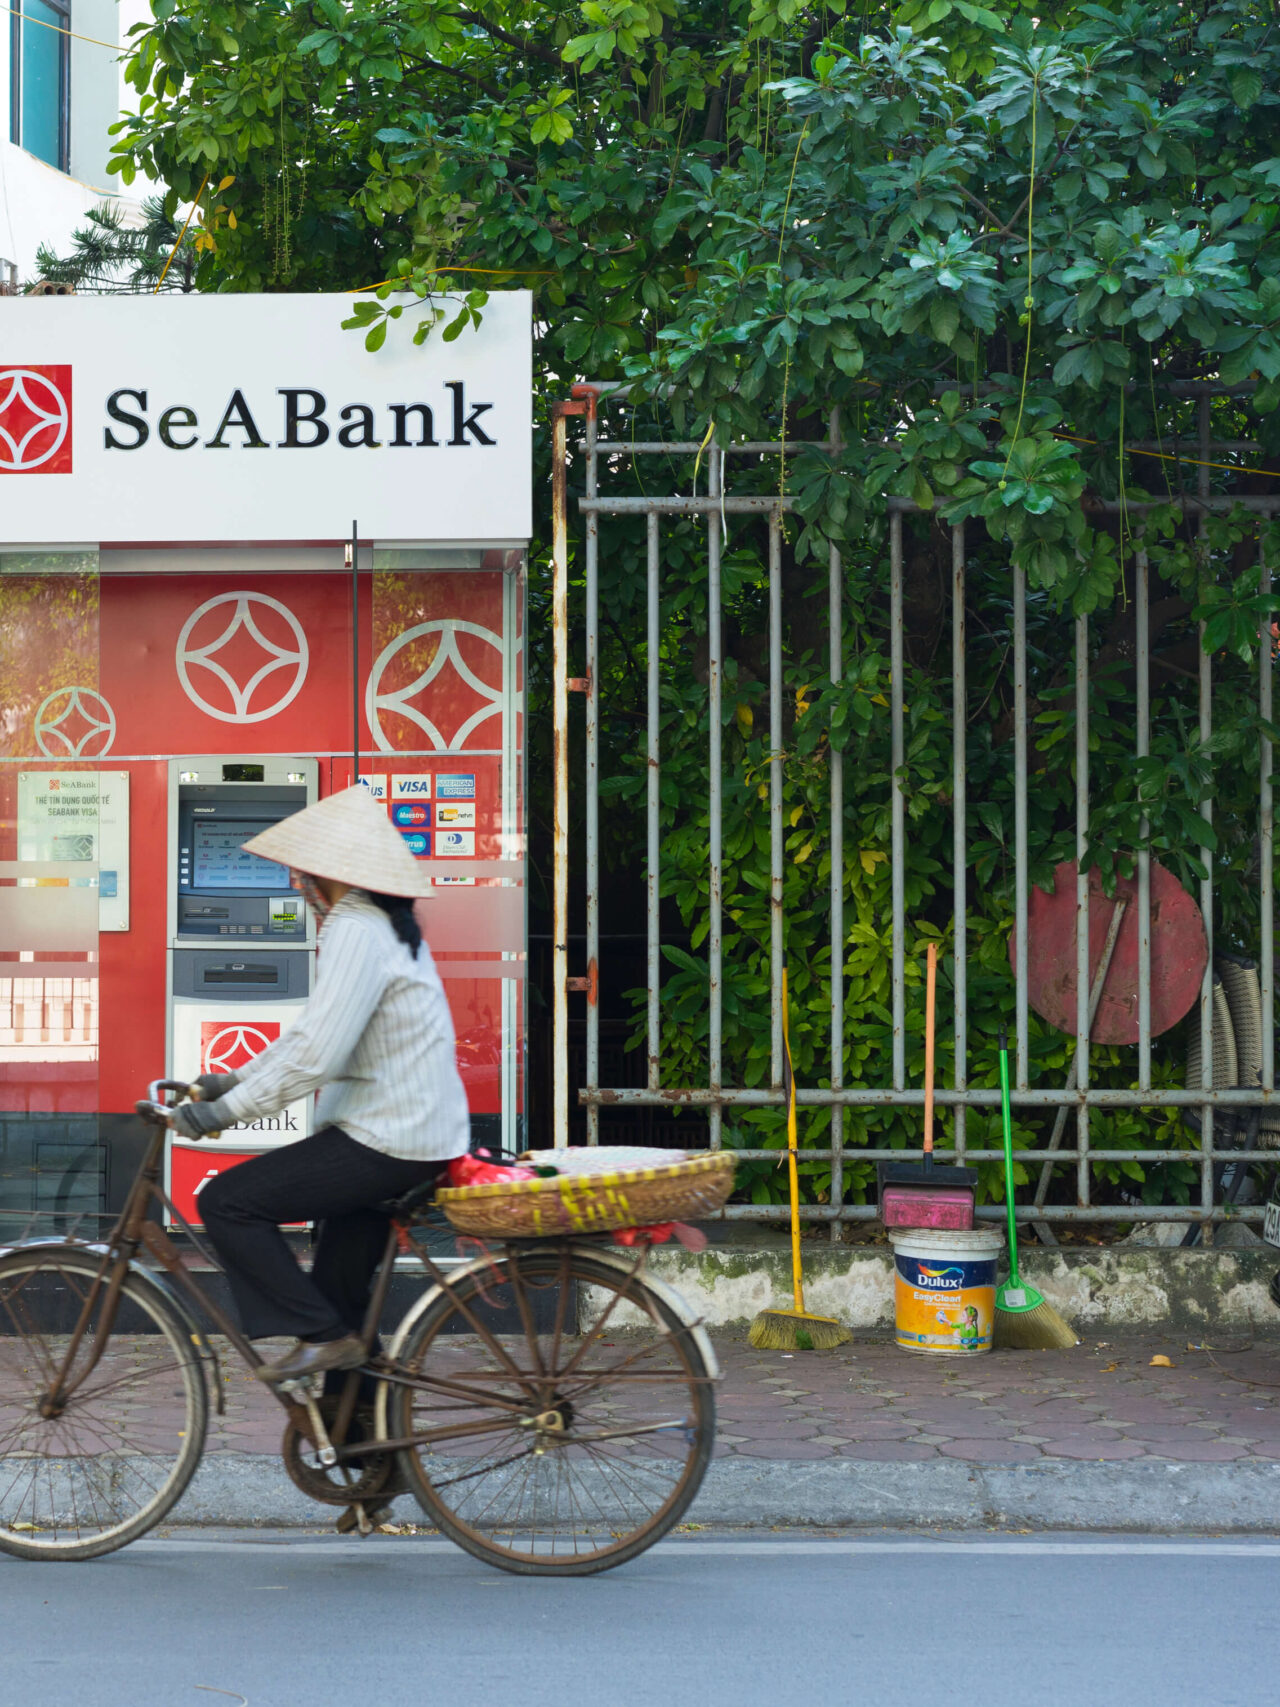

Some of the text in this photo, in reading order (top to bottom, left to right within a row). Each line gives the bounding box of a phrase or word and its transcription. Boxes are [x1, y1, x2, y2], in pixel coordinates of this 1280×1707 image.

[103, 380, 498, 451] SeABank
[61, 781, 97, 789] SeABank
[397, 781, 428, 793] VISA
[48, 807, 98, 816] SEABANK VISA
[399, 811, 425, 820] Maestro
[918, 1273, 958, 1288] Dulux
[913, 1291, 961, 1303] EasyClean
